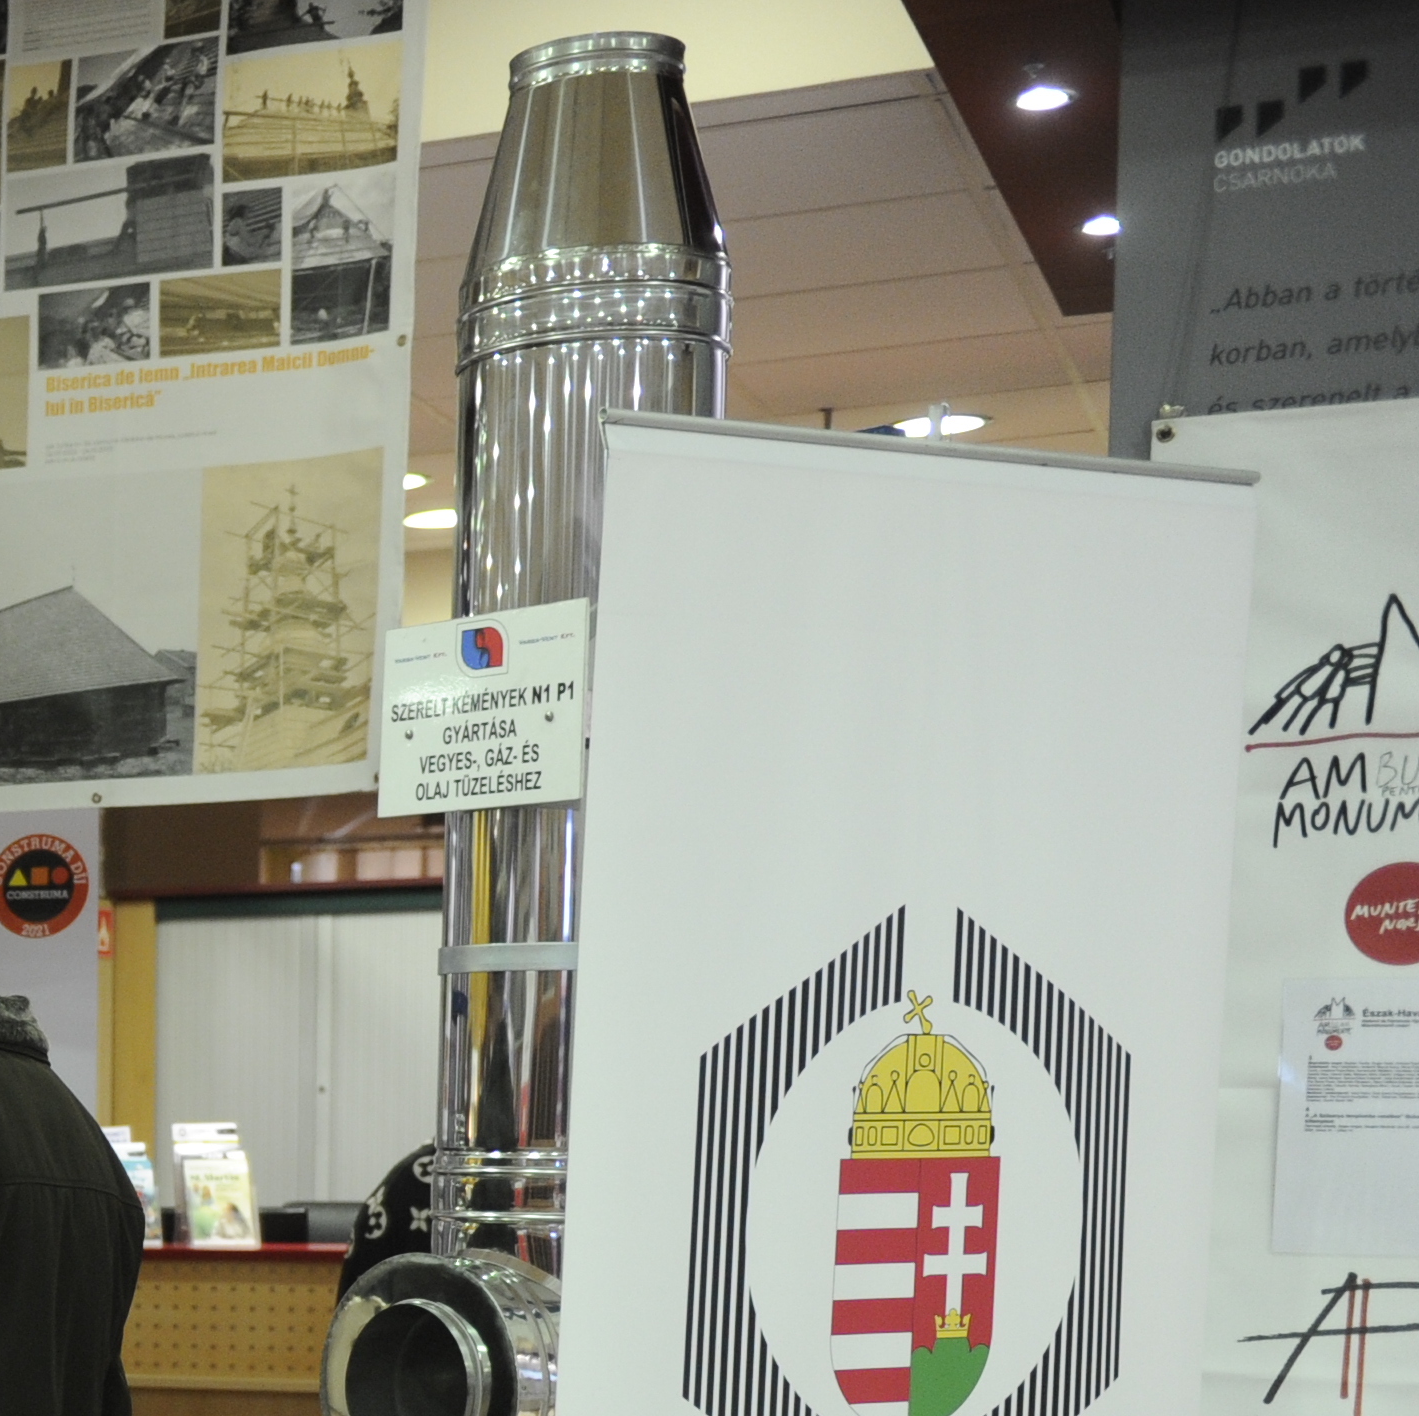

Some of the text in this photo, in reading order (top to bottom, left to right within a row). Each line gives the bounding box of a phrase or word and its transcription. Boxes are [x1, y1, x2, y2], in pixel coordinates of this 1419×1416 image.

[1214, 134, 1366, 168] GONDOLATOK
[1214, 162, 1337, 192] CSARNOKA
[1324, 282, 1341, 301] a
[1209, 338, 1312, 366] korban,
[45, 369, 113, 394] Biserica
[115, 368, 136, 388] de
[138, 365, 180, 384] lemn
[44, 398, 67, 417] lui
[391, 681, 575, 723] SZERELT KÉMÉNYEK N1 P1
[443, 716, 517, 745] GYÁRTÁSA
[420, 740, 540, 776] VEGYES-, GÁZ- ÉS
[415, 770, 542, 801] OLAJ TÜZELÉSHEZ
[6, 889, 69, 900] CONSTRUMA
[1350, 899, 1419, 920] MUNTE
[21, 923, 50, 938] 2021
